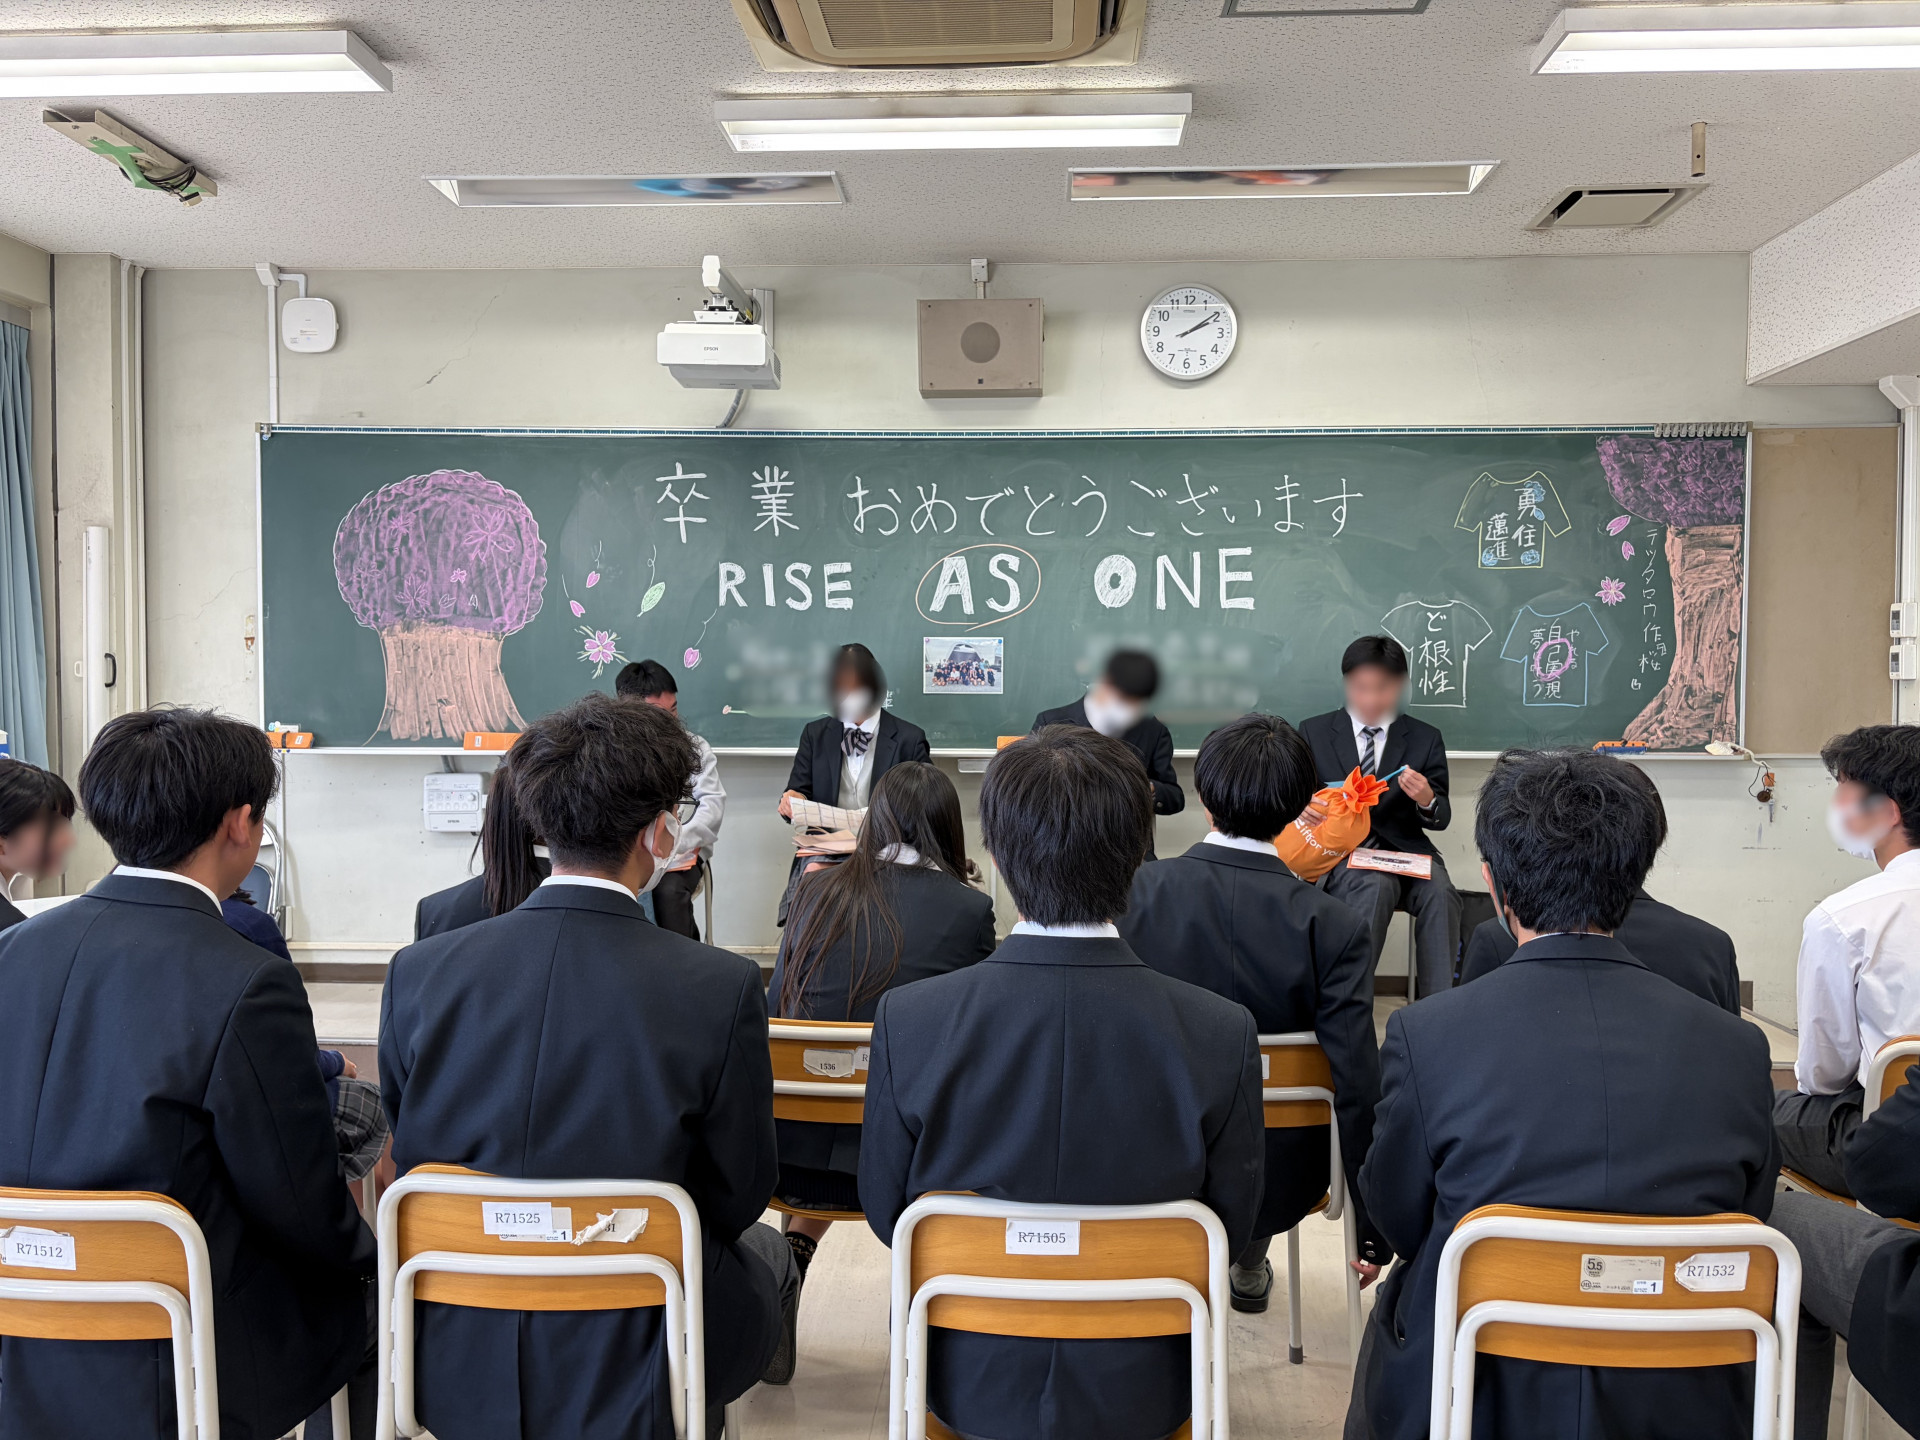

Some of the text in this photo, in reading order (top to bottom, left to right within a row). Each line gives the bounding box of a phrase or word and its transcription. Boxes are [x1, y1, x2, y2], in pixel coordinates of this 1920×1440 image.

[1170, 299, 1180, 310] 11
[1184, 295, 1196, 305] 12
[1203, 300, 1208, 311] 1
[1158, 310, 1170, 322] 10
[1213, 311, 1220, 322] 2
[1153, 326, 1160, 337] 9
[1217, 328, 1224, 339] 3
[1156, 342, 1164, 353] 8
[1211, 343, 1219, 354] 4
[1168, 353, 1175, 365] 7
[1183, 358, 1190, 369] 6
[1199, 354, 1207, 366] 5
[656, 461, 1364, 544] 卒業 おめでとうございます
[718, 546, 1256, 615] RISE AS ONE
[1418, 611, 1456, 696] ど根性
[1546, 617, 1562, 699] 自己実現
[820, 1063, 836, 1071] 1536
[495, 1212, 541, 1224] R71525
[561, 1230, 567, 1241] 1
[1017, 1231, 1066, 1244] R71505
[16, 1242, 63, 1258] R71512
[1687, 1264, 1735, 1278] R71532
[1650, 1281, 1657, 1293] 1
